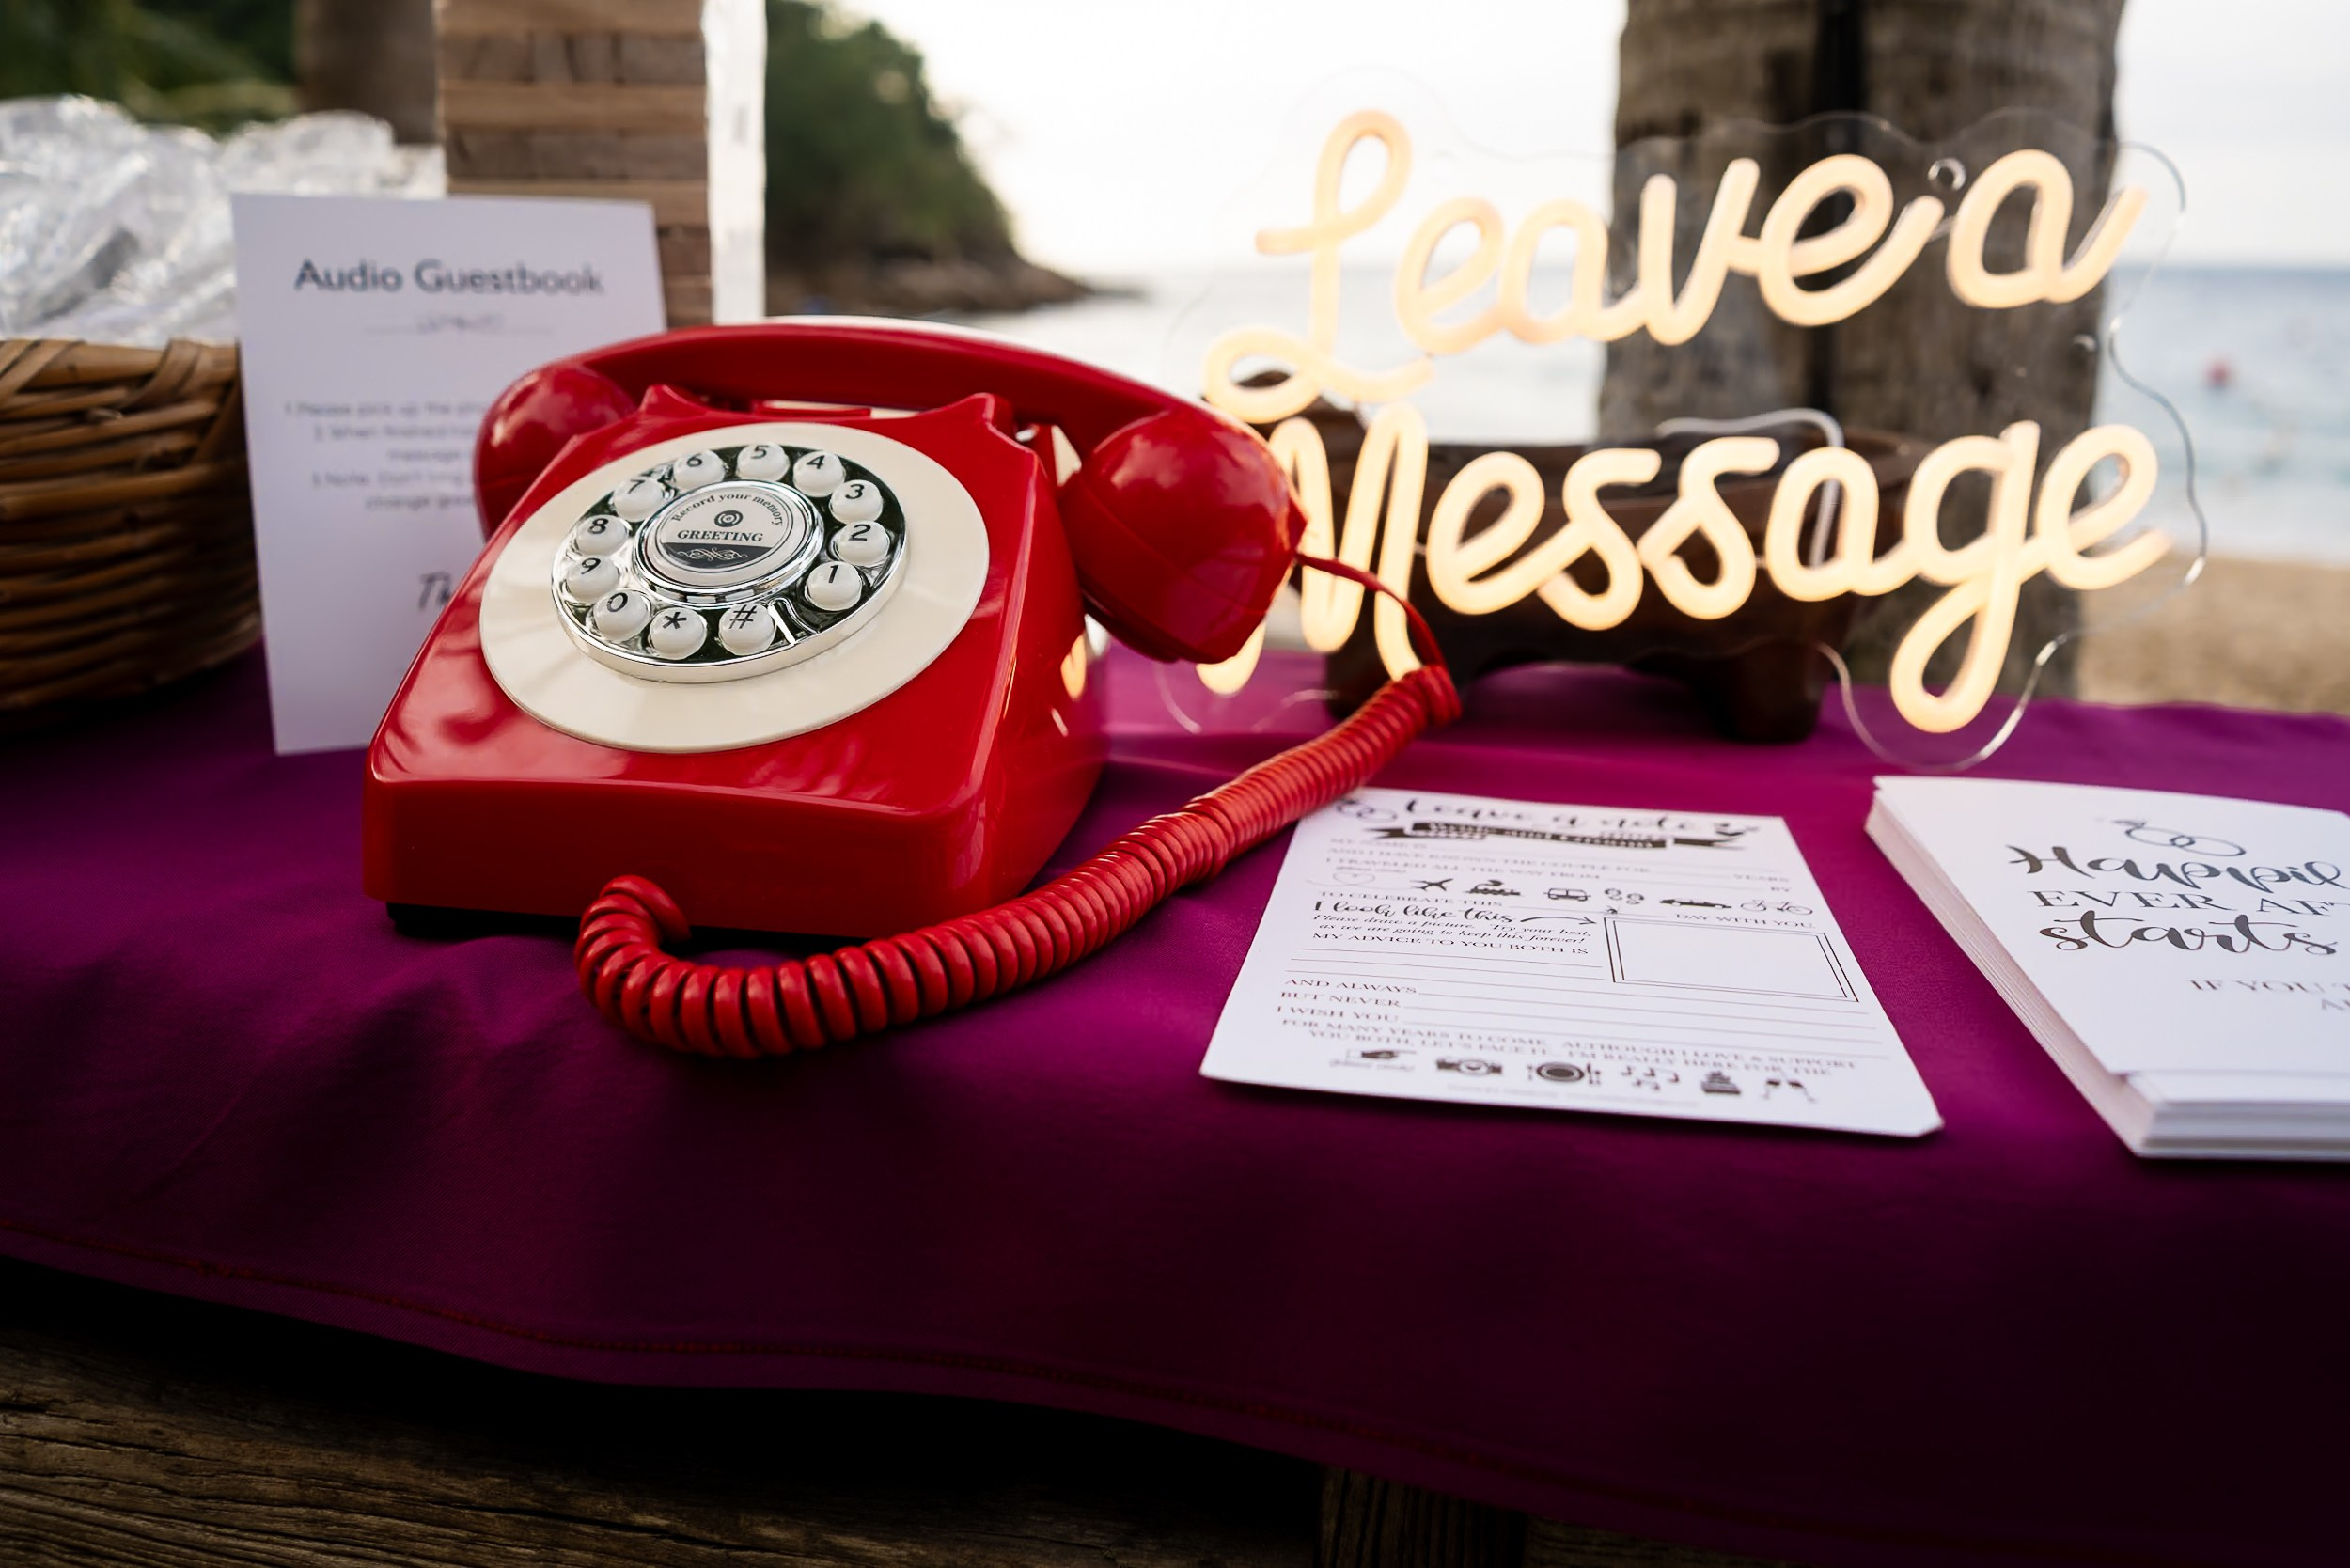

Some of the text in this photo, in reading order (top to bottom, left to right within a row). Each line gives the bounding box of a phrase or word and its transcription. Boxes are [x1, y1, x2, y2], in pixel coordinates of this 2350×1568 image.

[1204, 109, 2147, 423] Leave a
[293, 258, 605, 295] Audio Guestbook
[686, 453, 703, 468] 6
[753, 445, 768, 460] 5
[807, 455, 826, 470] 4
[628, 478, 647, 494] 7
[846, 483, 865, 500] 3
[671, 493, 784, 526] Record your memory
[588, 517, 609, 535] 8
[849, 524, 872, 542] 2
[677, 529, 763, 542] GREETING
[581, 557, 602, 575] 9
[827, 565, 839, 584] 1
[1197, 402, 2174, 734] Message
[606, 591, 629, 613] 0
[2005, 844, 2350, 894] Happil
[1314, 901, 1514, 923] I look like this
[1349, 892, 1453, 903] CELEBRATE
[1716, 916, 1767, 925] WITH
[2027, 890, 2350, 917] EVER AF
[1313, 914, 1359, 923] Please
[1420, 920, 1475, 930] picture.
[1490, 923, 1516, 933] Try
[2040, 909, 2338, 956] starts
[1348, 934, 1421, 944] ADVICE
[1461, 939, 1503, 948] YOU
[1508, 943, 1564, 952] BOTH
[1392, 927, 1434, 935] going
[1458, 930, 1492, 938] keep
[1496, 932, 1523, 940] this
[1523, 934, 1586, 944] forever!
[1284, 979, 1418, 994] AND ALWAYS
[2232, 980, 2326, 994] YOU
[1280, 991, 1402, 1008] BUT NEVER
[1290, 1006, 1345, 1017] WISH
[1353, 1011, 1399, 1021] YOU
[1282, 1018, 1319, 1027] FOR
[1326, 1022, 1383, 1033] MANY
[1389, 1027, 1449, 1039] YEARS
[1309, 1029, 1350, 1039] YOU
